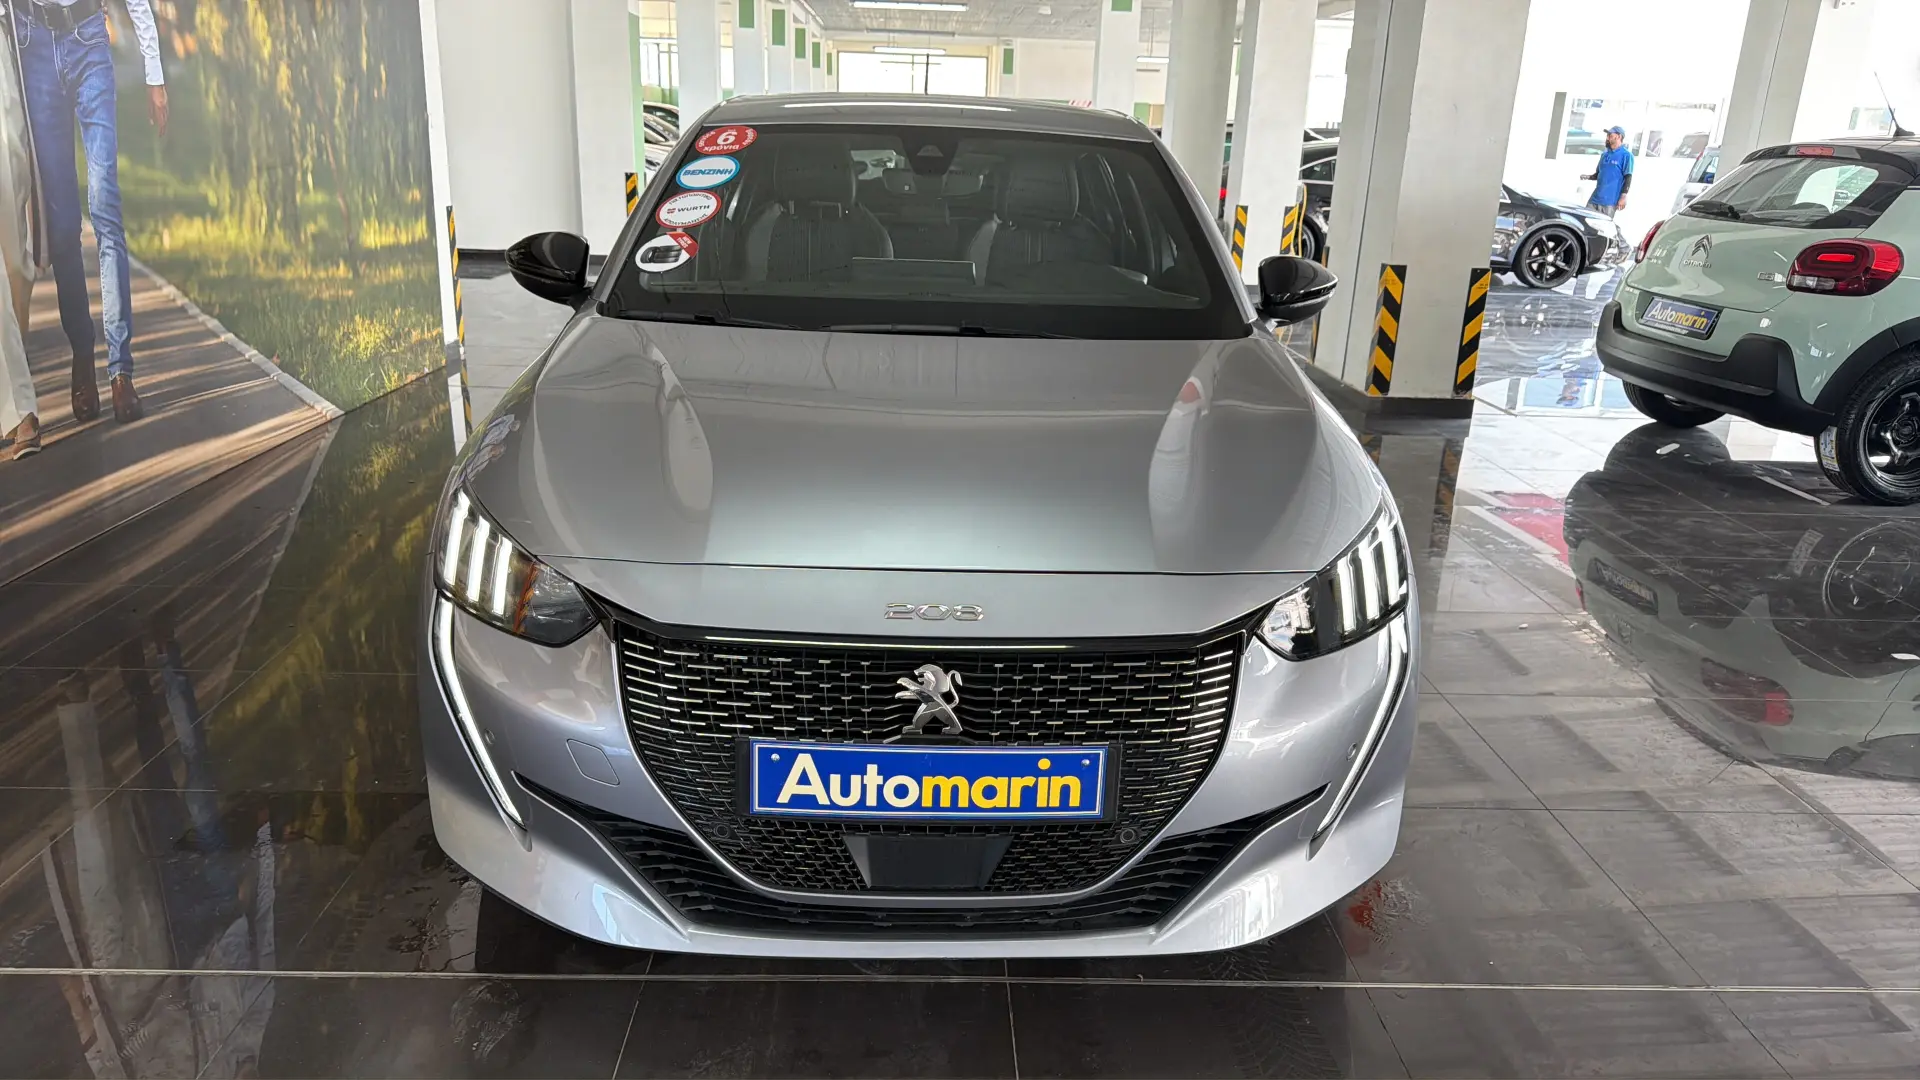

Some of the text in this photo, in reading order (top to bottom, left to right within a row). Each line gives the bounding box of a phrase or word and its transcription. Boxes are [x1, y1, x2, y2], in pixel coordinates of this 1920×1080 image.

[716, 131, 738, 145] 6
[703, 144, 739, 152] χρόνια
[681, 235, 693, 245] NEW
[1647, 301, 1708, 330] Automarin
[884, 602, 984, 621] 208
[776, 752, 1081, 808] Automarin
